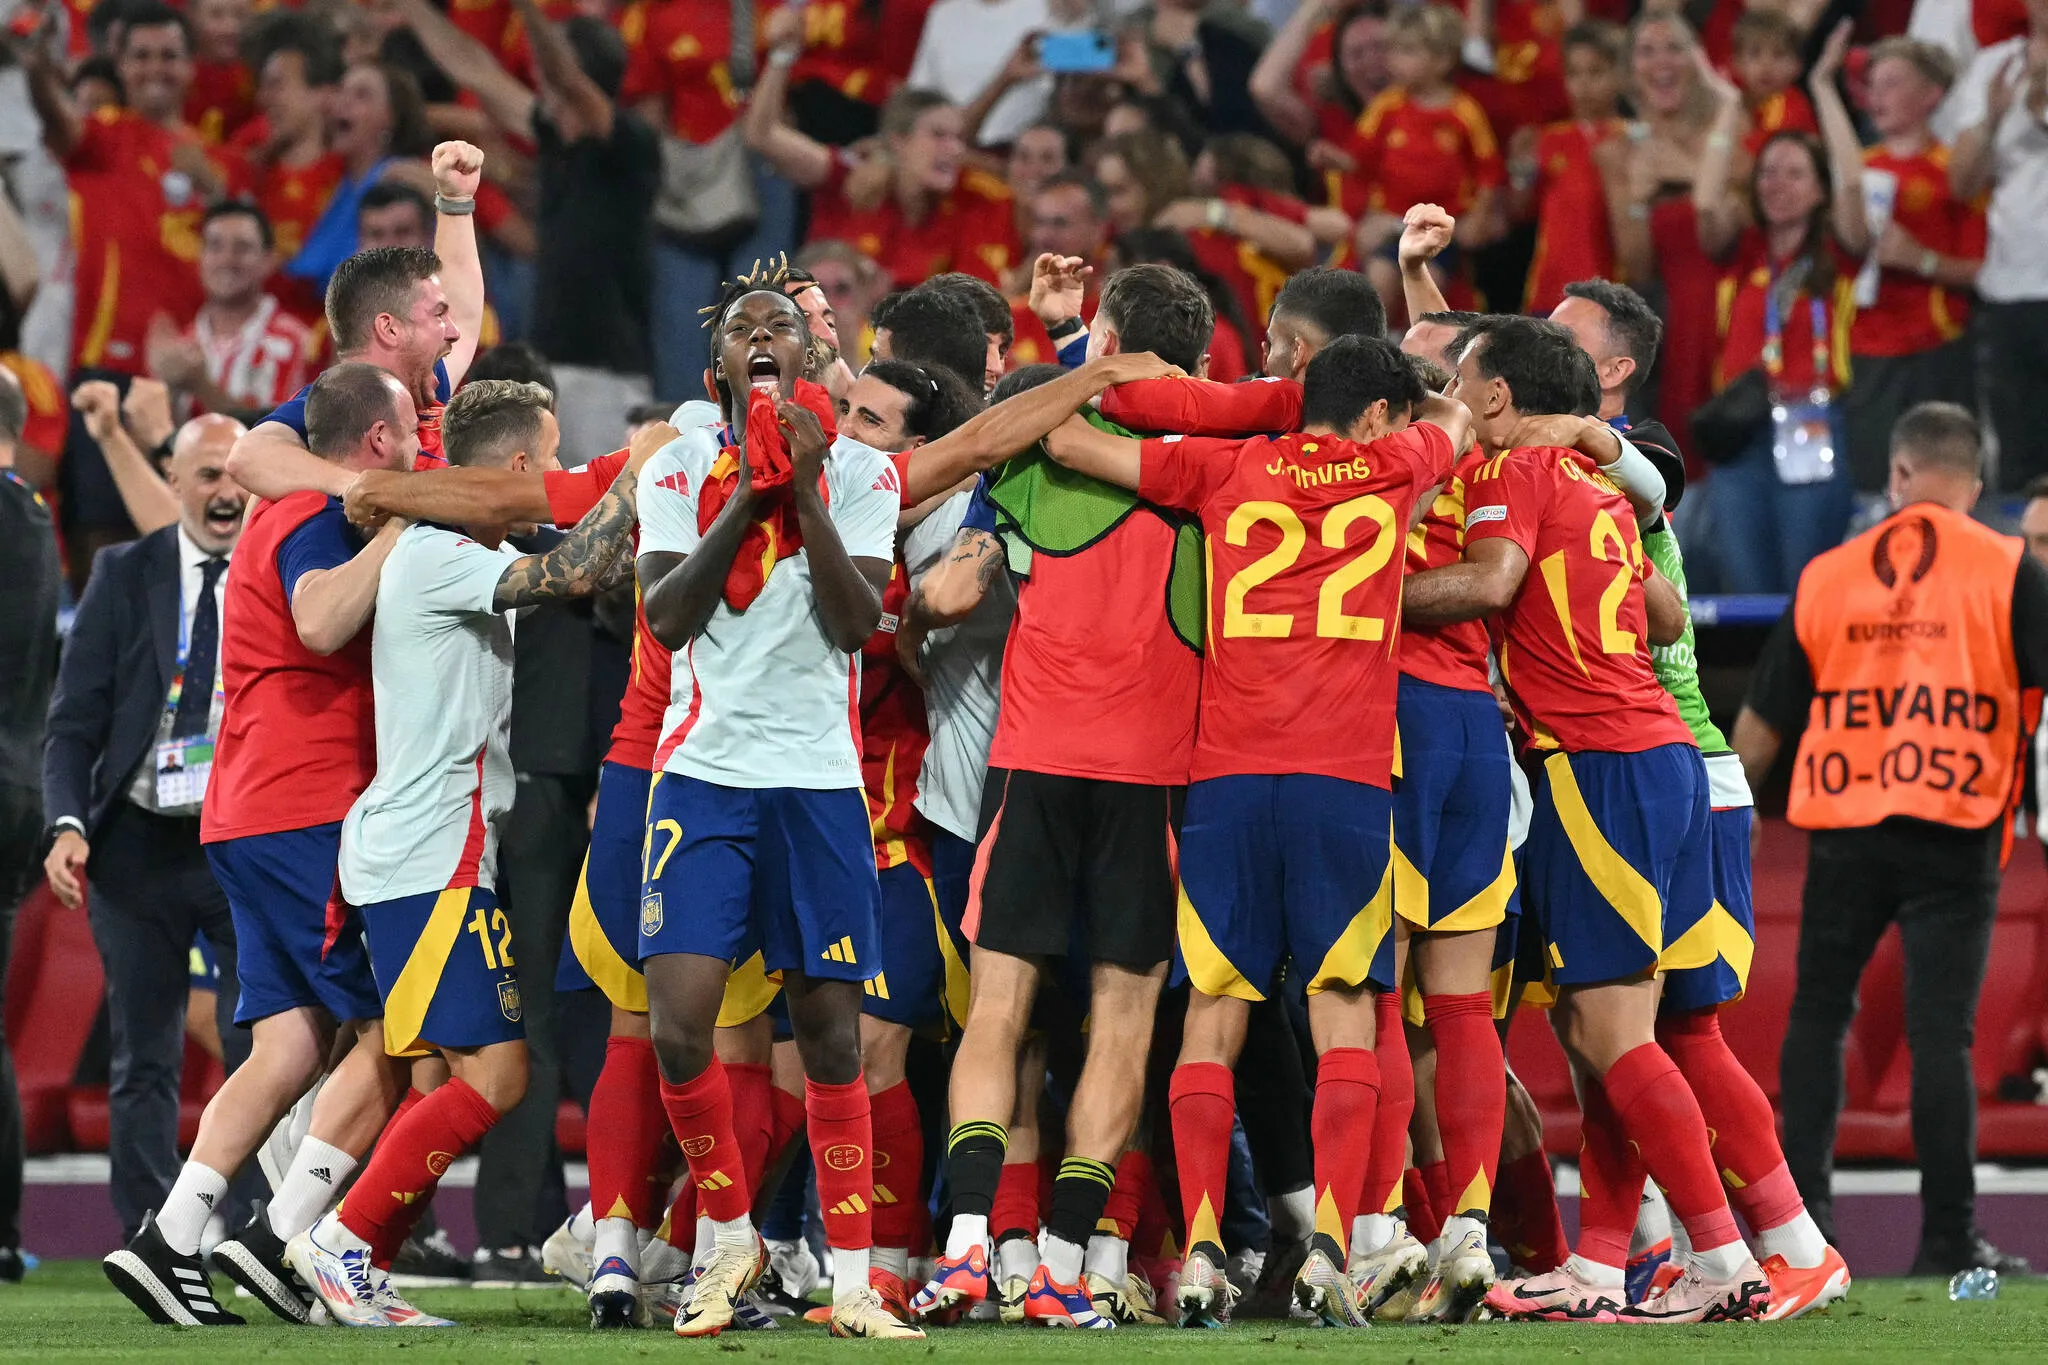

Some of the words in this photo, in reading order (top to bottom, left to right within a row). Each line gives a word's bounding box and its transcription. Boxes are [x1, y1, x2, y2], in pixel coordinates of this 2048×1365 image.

[1223, 495, 1396, 641] 22
[641, 818, 683, 884] 17
[467, 907, 515, 970] 12
